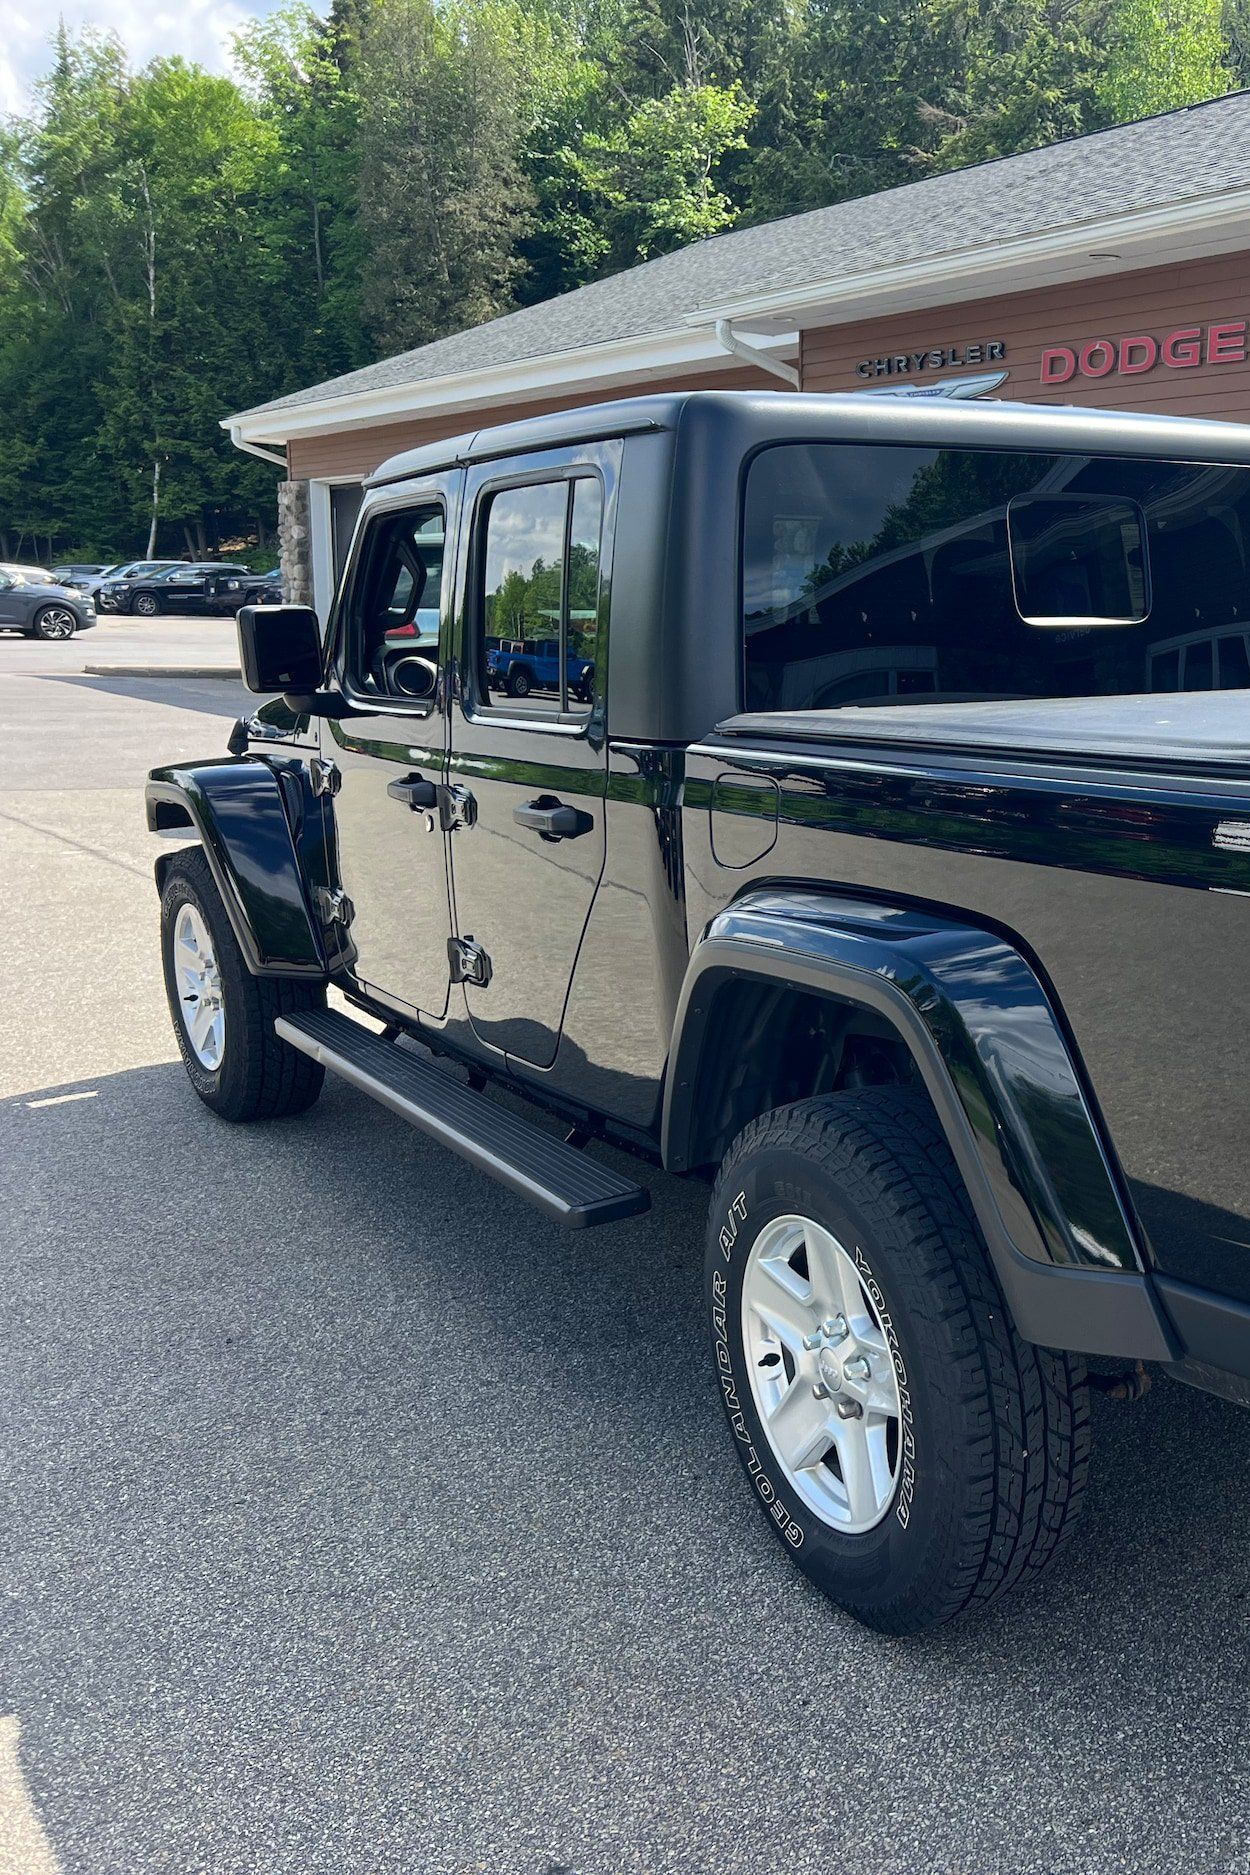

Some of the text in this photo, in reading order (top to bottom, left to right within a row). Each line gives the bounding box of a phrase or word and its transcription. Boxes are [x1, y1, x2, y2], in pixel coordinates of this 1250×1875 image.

[855, 341, 1006, 379] CHRYSLER
[1040, 321, 1247, 384] DODGE
[712, 1270, 805, 1549] GEOLANDAR
[854, 1246, 917, 1529] YOKOHAMA
